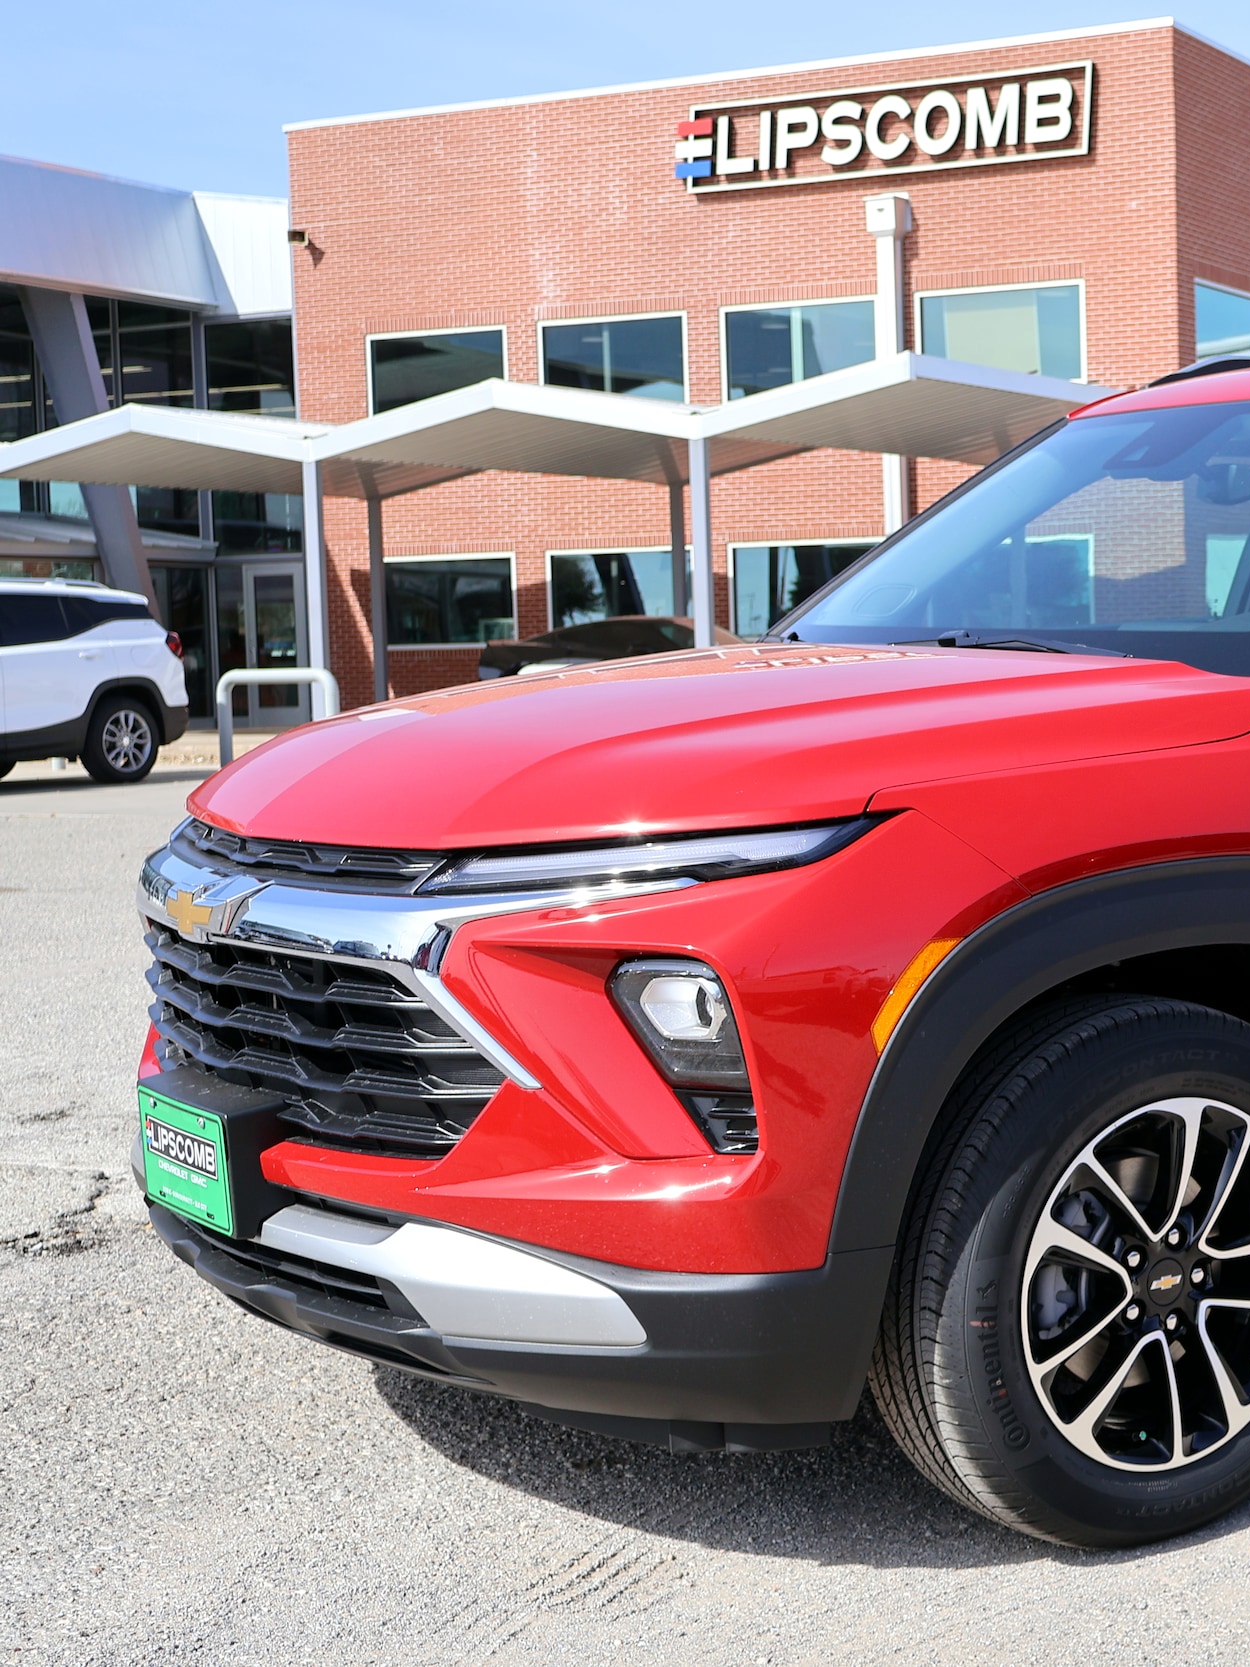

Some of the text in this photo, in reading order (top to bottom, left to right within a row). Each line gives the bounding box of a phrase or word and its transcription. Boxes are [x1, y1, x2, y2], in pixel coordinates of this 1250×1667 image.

[715, 77, 1074, 176] LIPSCOMB
[151, 1122, 215, 1173] LIPSCOMB
[158, 1159, 207, 1188] CHEVROLET GMC
